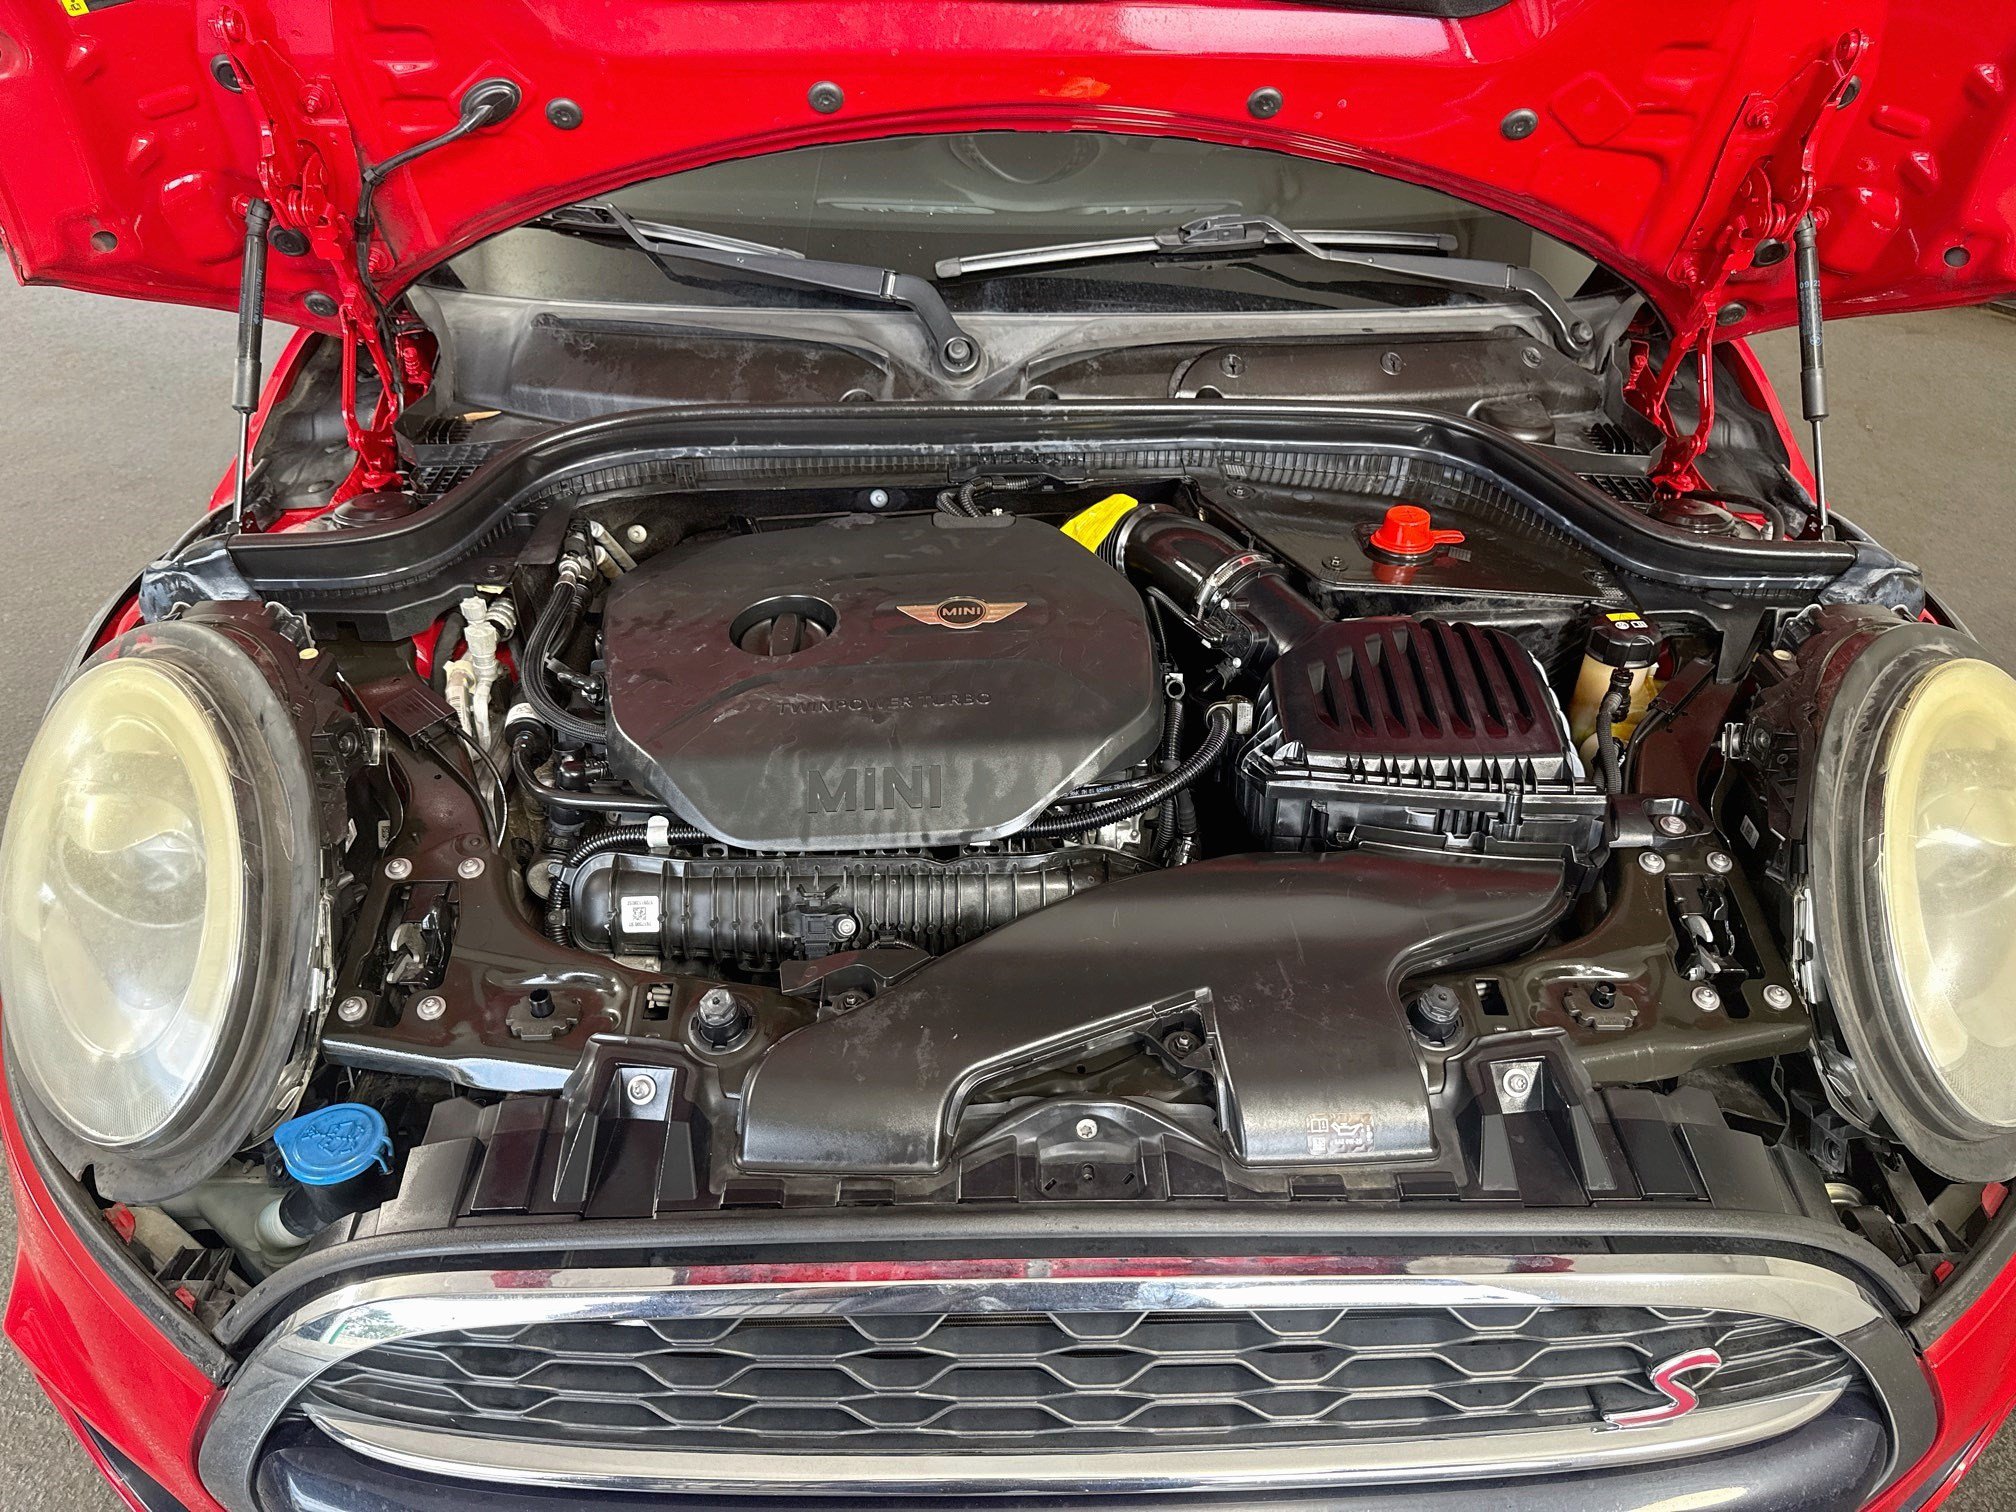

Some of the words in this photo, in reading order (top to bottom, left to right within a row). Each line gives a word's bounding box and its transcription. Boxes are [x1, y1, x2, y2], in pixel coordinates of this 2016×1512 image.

[942, 607, 981, 617] MINI
[777, 696, 913, 716] TWINPOWER
[918, 693, 992, 708] TURBO
[807, 764, 942, 814] MINI
[1602, 1347, 1722, 1429] S
